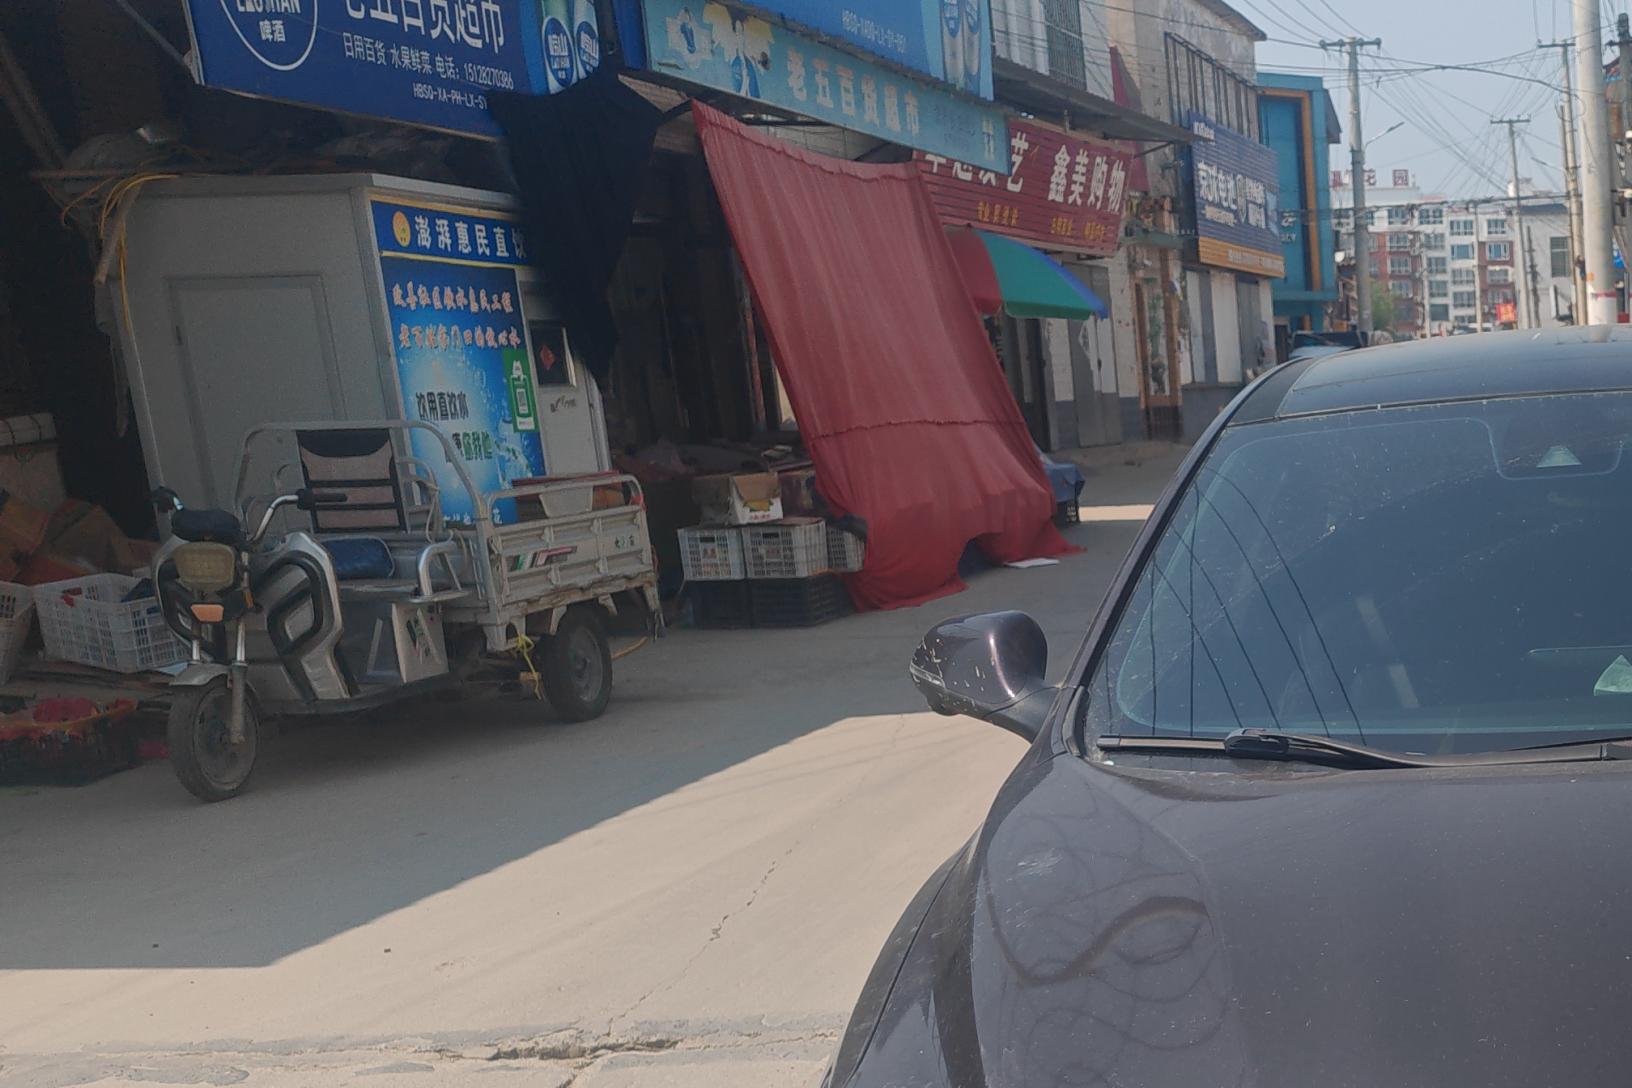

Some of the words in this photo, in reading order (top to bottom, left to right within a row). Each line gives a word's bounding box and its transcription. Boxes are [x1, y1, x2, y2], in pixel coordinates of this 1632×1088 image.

[259, 19, 286, 42] 啤酒
[342, 31, 387, 66] 日用百货
[390, 43, 433, 75] 水果鲜菜
[1047, 144, 1126, 212] 鑫美购物
